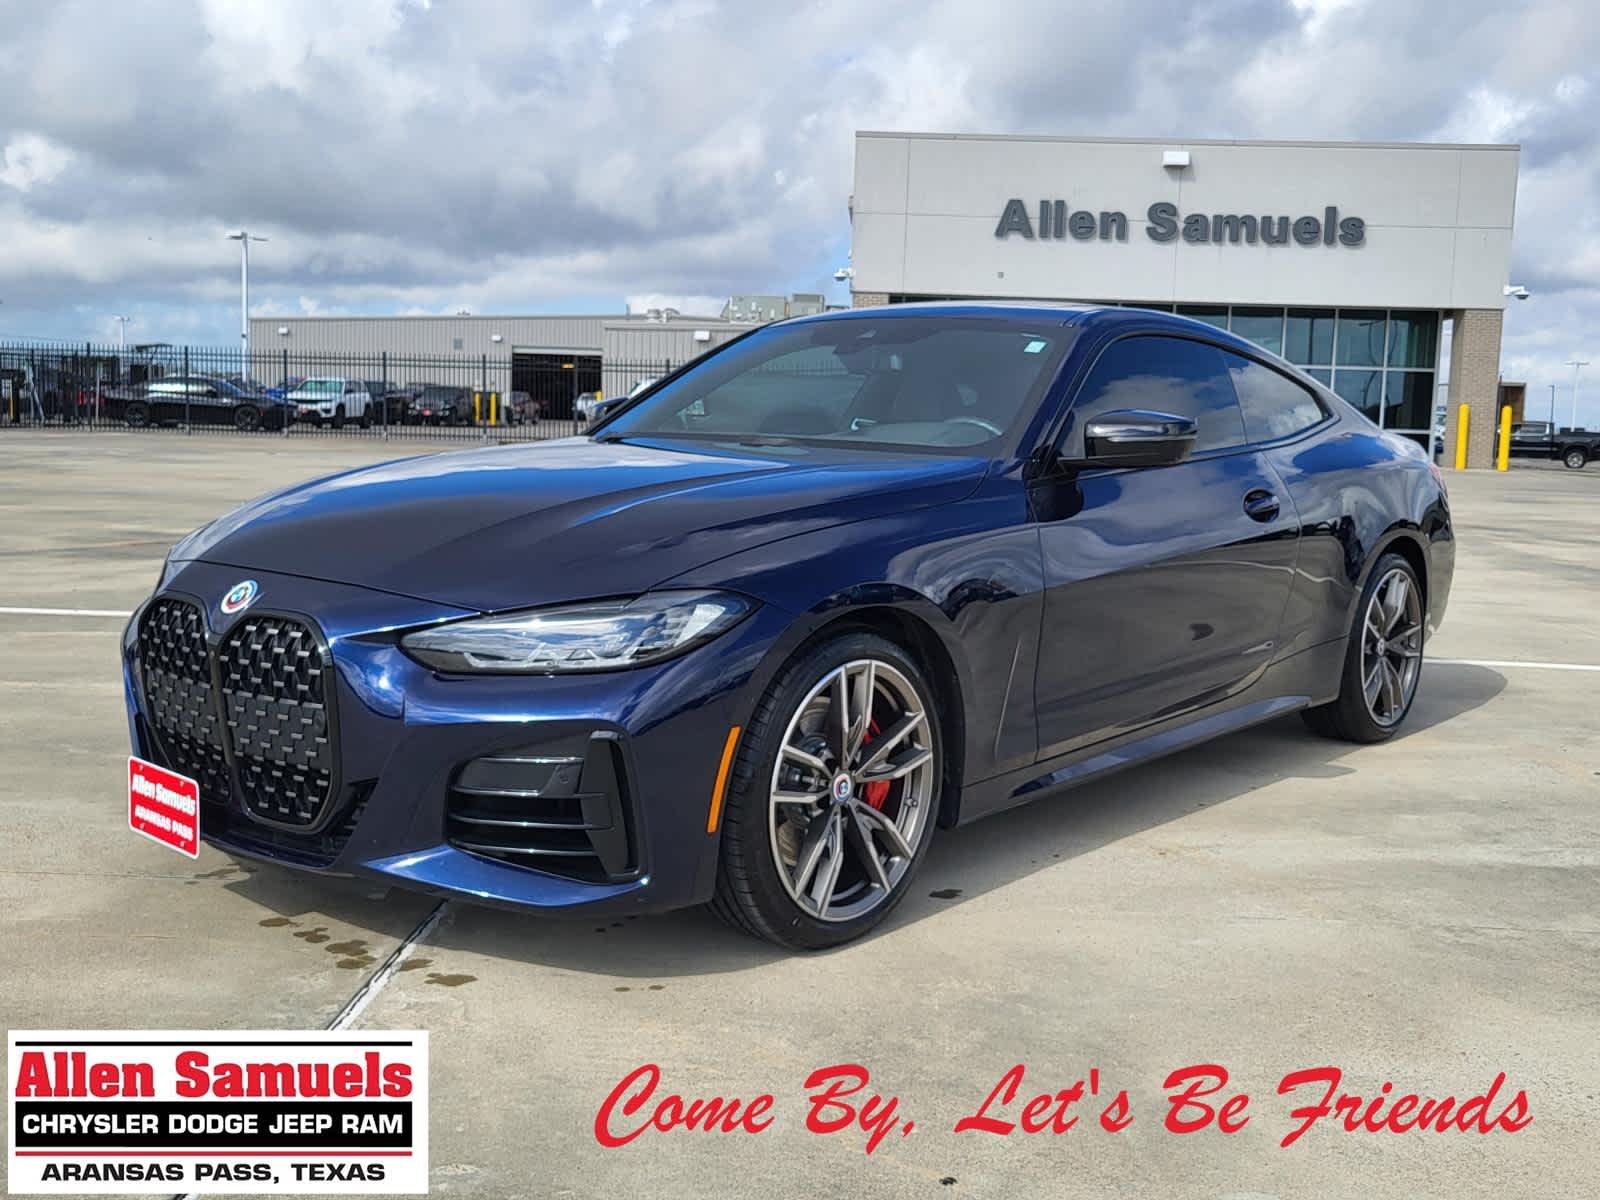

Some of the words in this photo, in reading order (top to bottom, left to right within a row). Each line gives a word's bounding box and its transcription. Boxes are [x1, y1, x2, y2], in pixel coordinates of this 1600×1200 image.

[995, 199, 1127, 241] Allen
[1146, 202, 1365, 247] Samuels
[132, 774, 156, 800] Allen
[155, 783, 196, 816] Samuels
